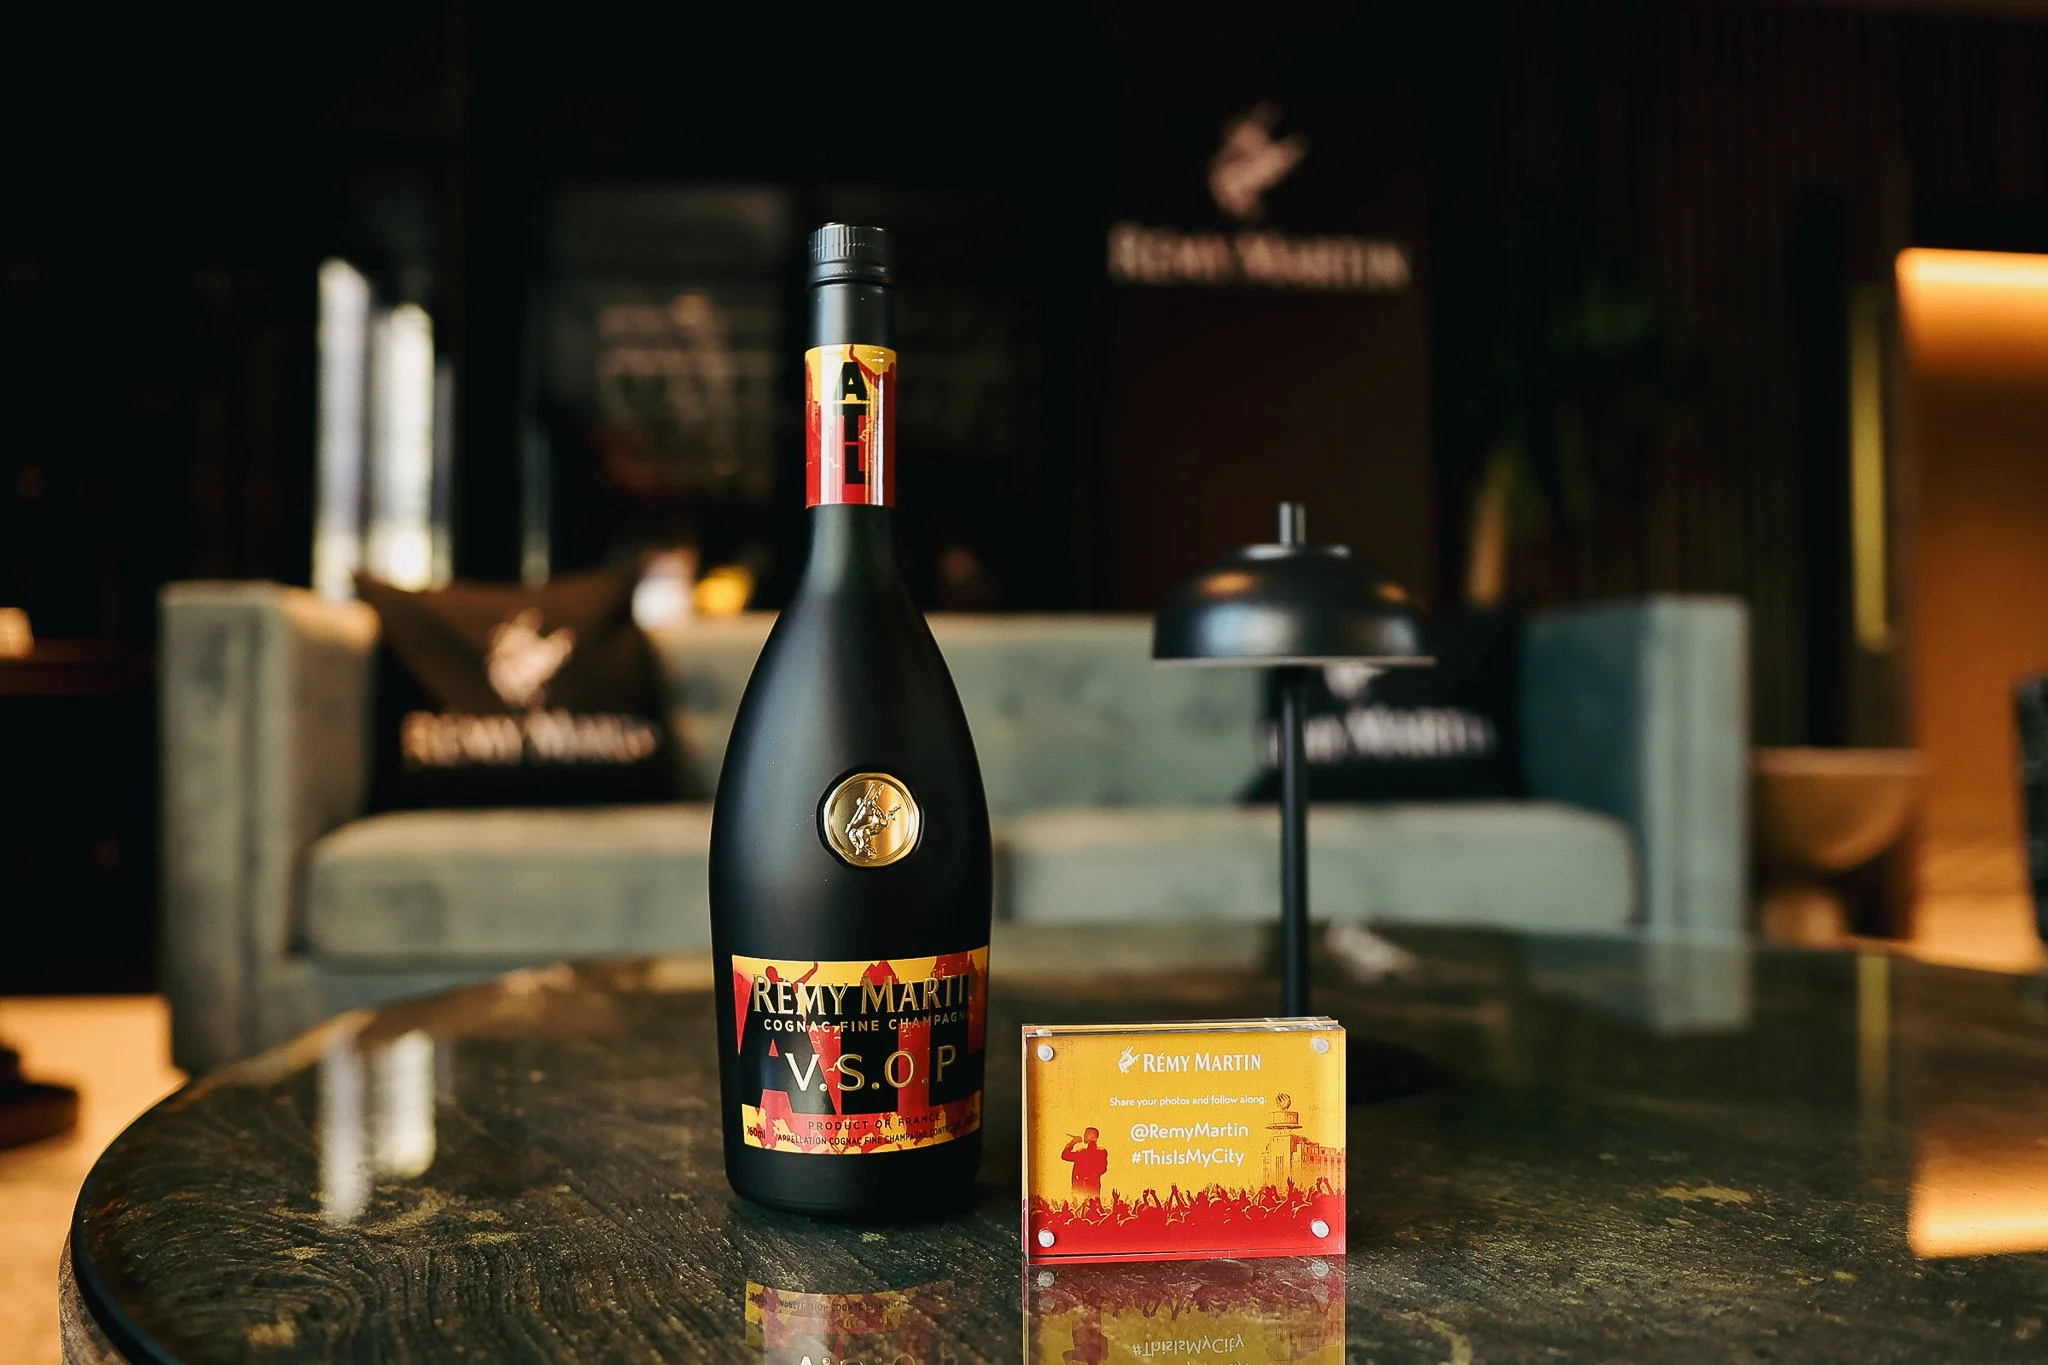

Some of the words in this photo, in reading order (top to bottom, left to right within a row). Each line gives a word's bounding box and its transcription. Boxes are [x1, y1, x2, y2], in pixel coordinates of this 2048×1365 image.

[859, 973, 970, 1014] MARTI
[840, 1020, 880, 1033] FINE
[888, 1008, 970, 1031] CHAMPAGN
[1143, 1052, 1191, 1073] RÉMY
[1194, 1051, 1262, 1072] MARTIN
[1109, 1096, 1135, 1107] Share
[1137, 1098, 1157, 1108] your
[1159, 1096, 1190, 1108] photos
[1192, 1095, 1209, 1105] and
[1211, 1094, 1238, 1105] follow
[1239, 1094, 1267, 1107] along.
[808, 1121, 868, 1132] PRODUCT
[898, 1112, 942, 1128] FRANCE
[1130, 1122, 1249, 1142] @RemyMartin
[777, 1134, 827, 1146] APPELLATION
[828, 1136, 863, 1146] COGNAC
[864, 1134, 882, 1145] FINE
[1131, 1148, 1245, 1168] #ThisIsMyCity
